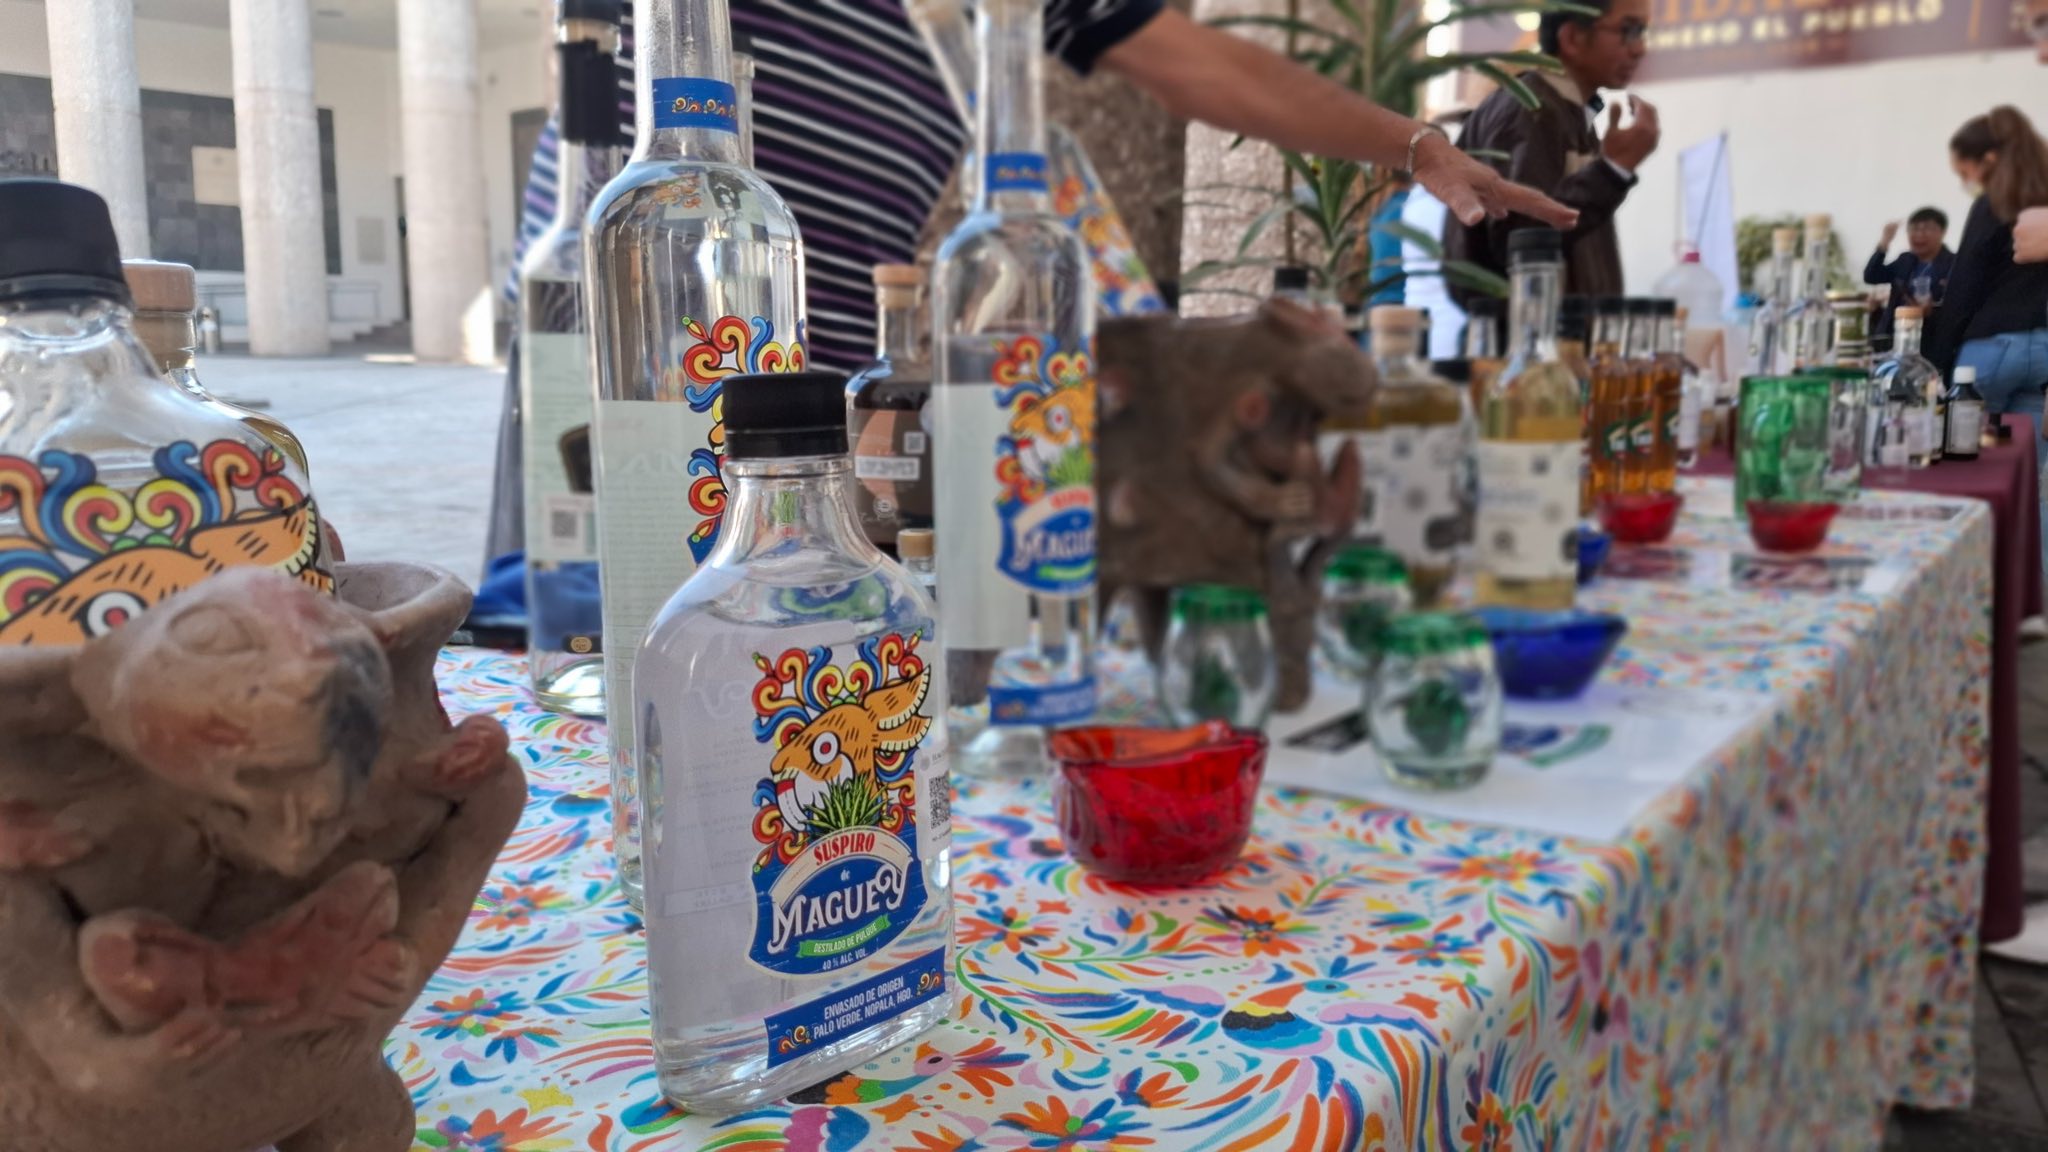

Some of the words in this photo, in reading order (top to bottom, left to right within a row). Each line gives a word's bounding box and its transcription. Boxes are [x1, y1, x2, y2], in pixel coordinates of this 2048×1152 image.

[1751, 15, 1789, 42] EL
[1801, 0, 1943, 33] PUEBLO
[813, 831, 876, 867] SUSPIRO
[839, 868, 851, 882] de
[766, 856, 914, 954] MAGUEY
[813, 939, 847, 953] DESTILADO
[846, 935, 856, 947] DE
[855, 921, 878, 943] PULQUE
[822, 959, 832, 971] 40
[832, 957, 840, 967] %
[840, 952, 854, 965] ALC.
[813, 1020, 835, 1040] PALO
[864, 995, 896, 1019] NOPALA,
[896, 987, 914, 1004] HGO.
[824, 992, 865, 1020] ENVASADO
[865, 987, 877, 1003] DE
[877, 975, 904, 998] ORIGEN
